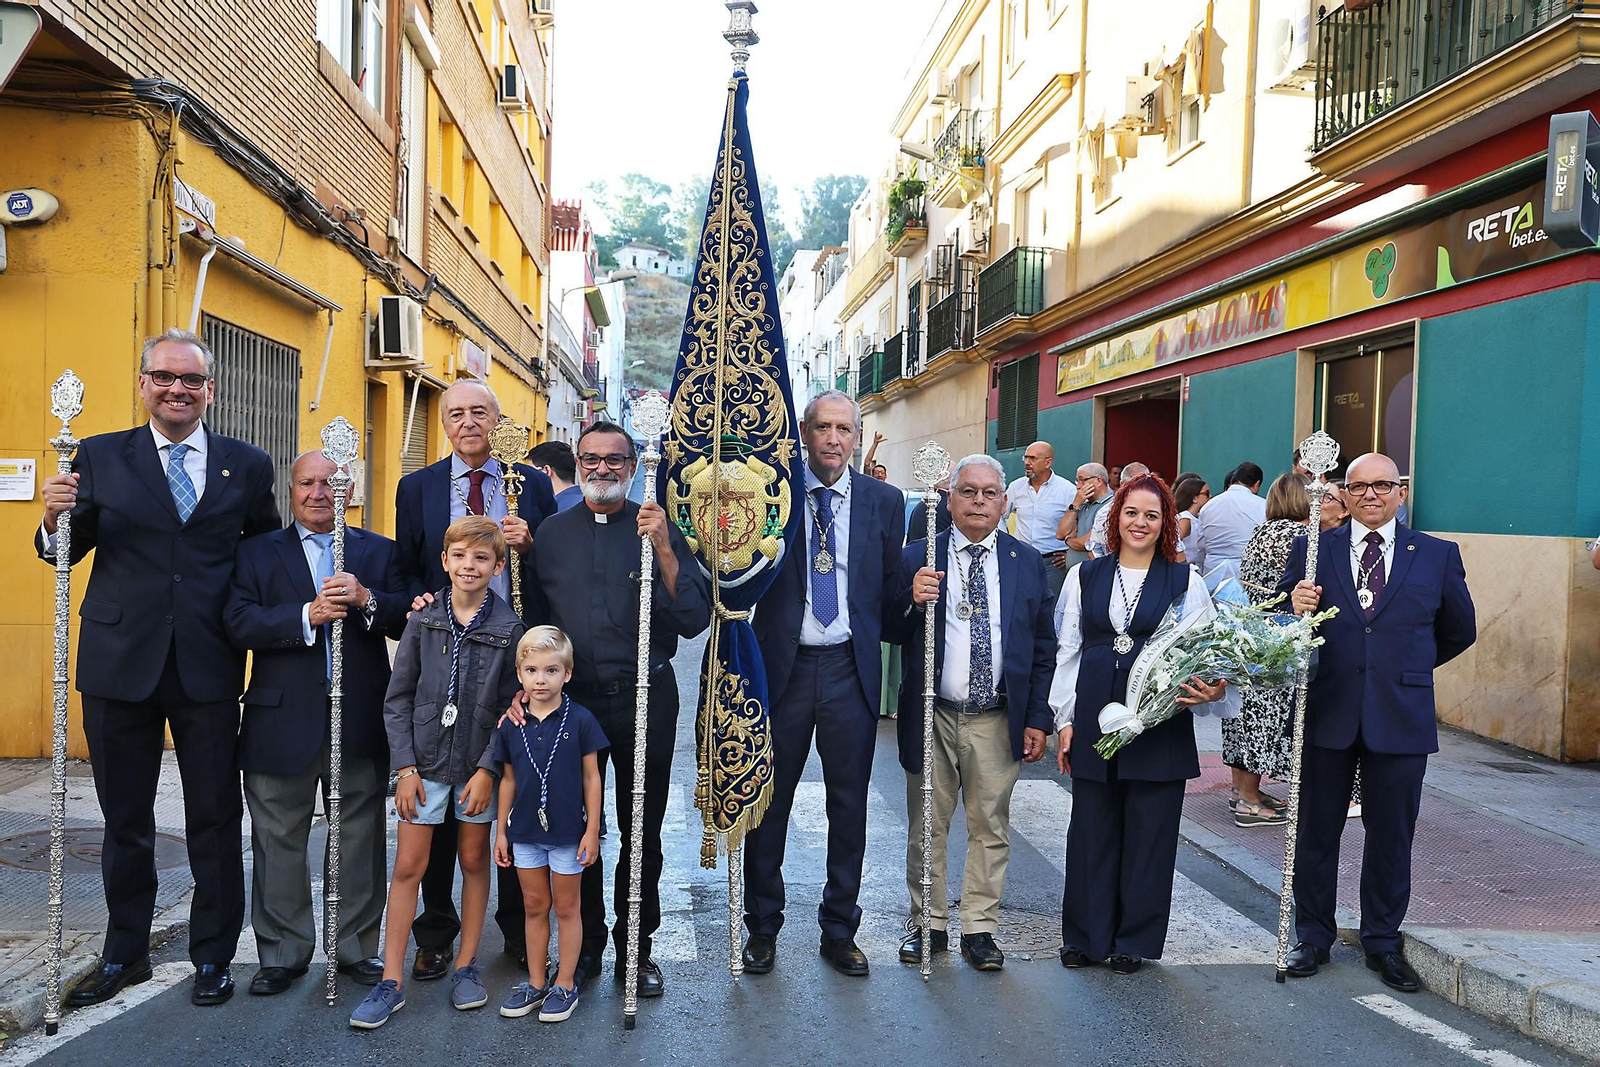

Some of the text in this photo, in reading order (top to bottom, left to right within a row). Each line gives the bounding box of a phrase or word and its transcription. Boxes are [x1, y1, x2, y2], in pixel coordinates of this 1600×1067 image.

[1568, 145, 1576, 167] bet.es
[1555, 155, 1571, 197] RETA
[12, 199, 28, 210] ADT
[191, 192, 214, 222] BOSCO
[1467, 202, 1534, 246] RETA
[1189, 280, 1287, 352] COLONIAS
[1334, 392, 1359, 405] RETA
